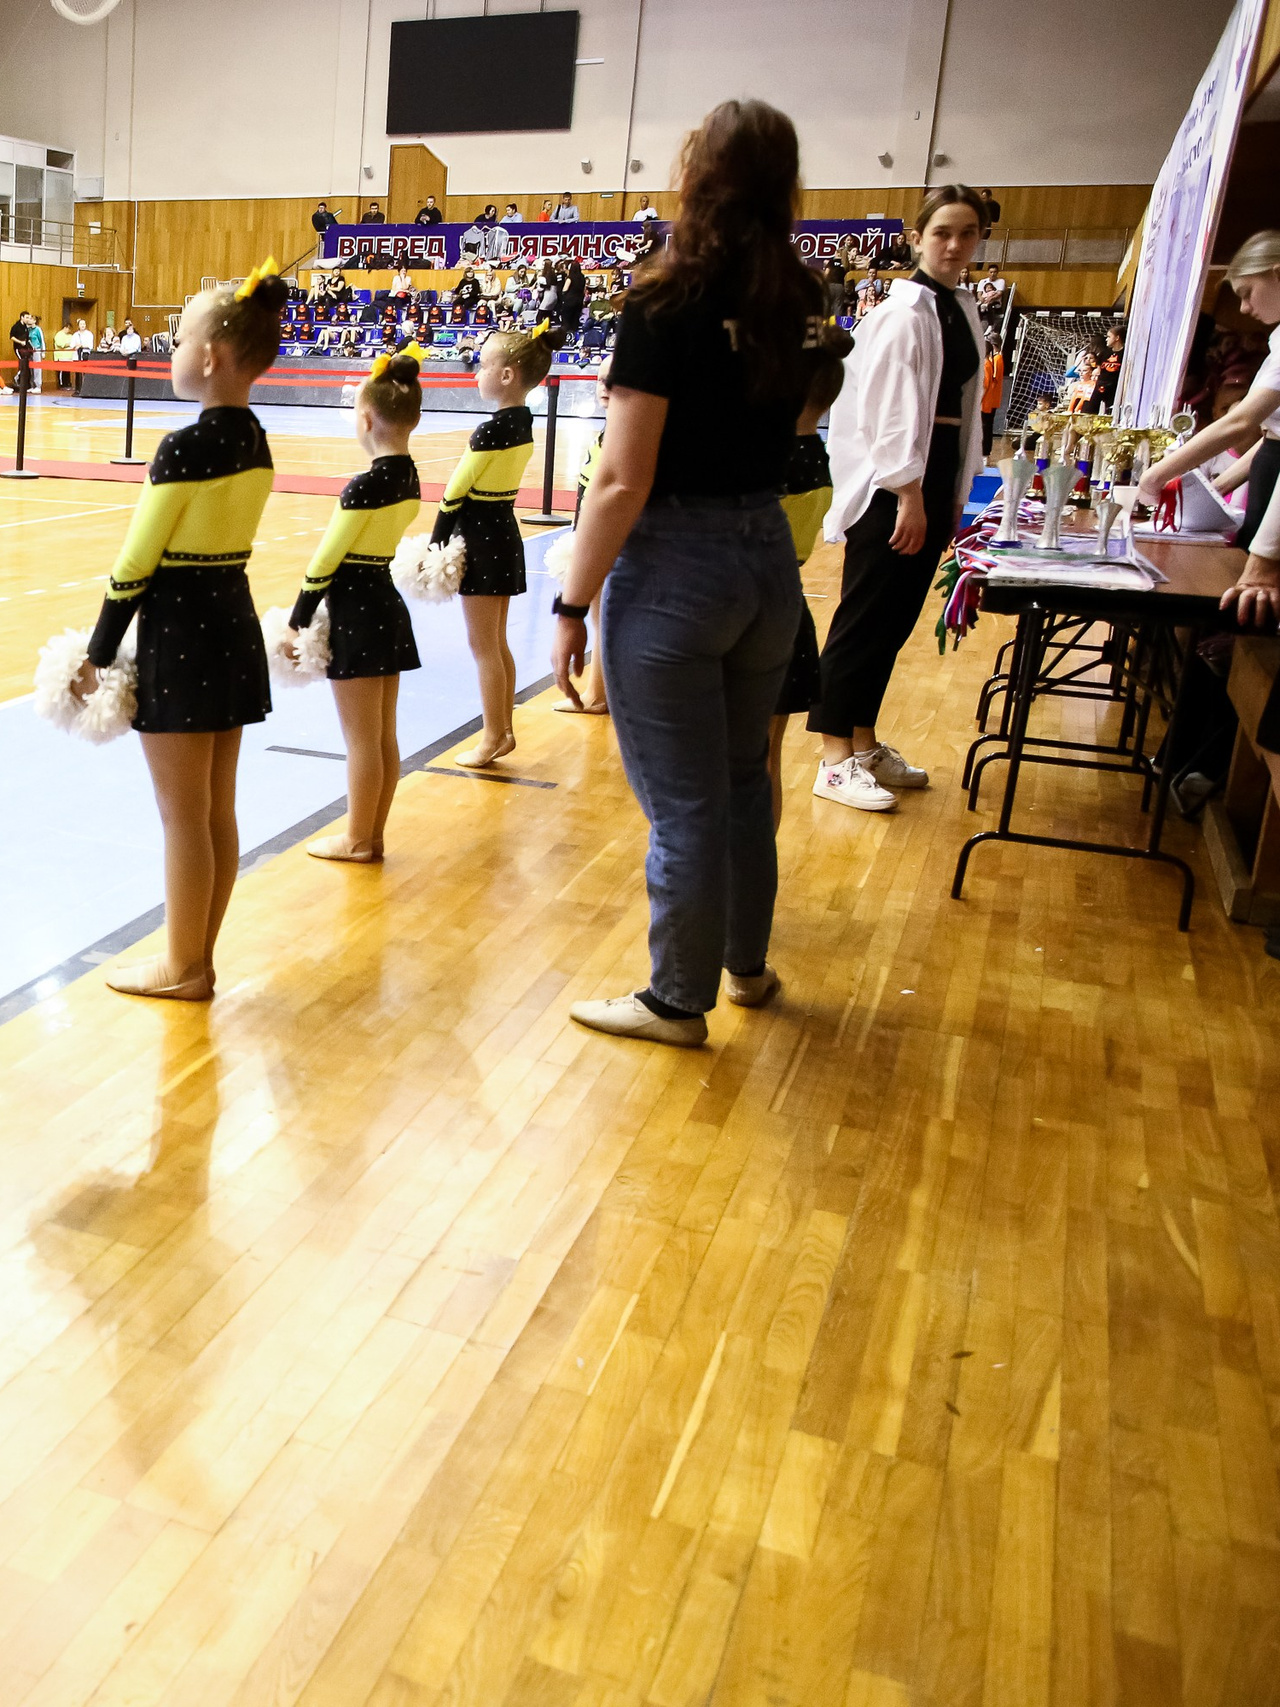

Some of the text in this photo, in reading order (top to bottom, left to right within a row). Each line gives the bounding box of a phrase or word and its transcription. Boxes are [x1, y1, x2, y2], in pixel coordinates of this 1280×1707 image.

[337, 234, 644, 261] ВПЕРЕД ЛЯБИНСК
[790, 228, 886, 259] ОБОЙ
